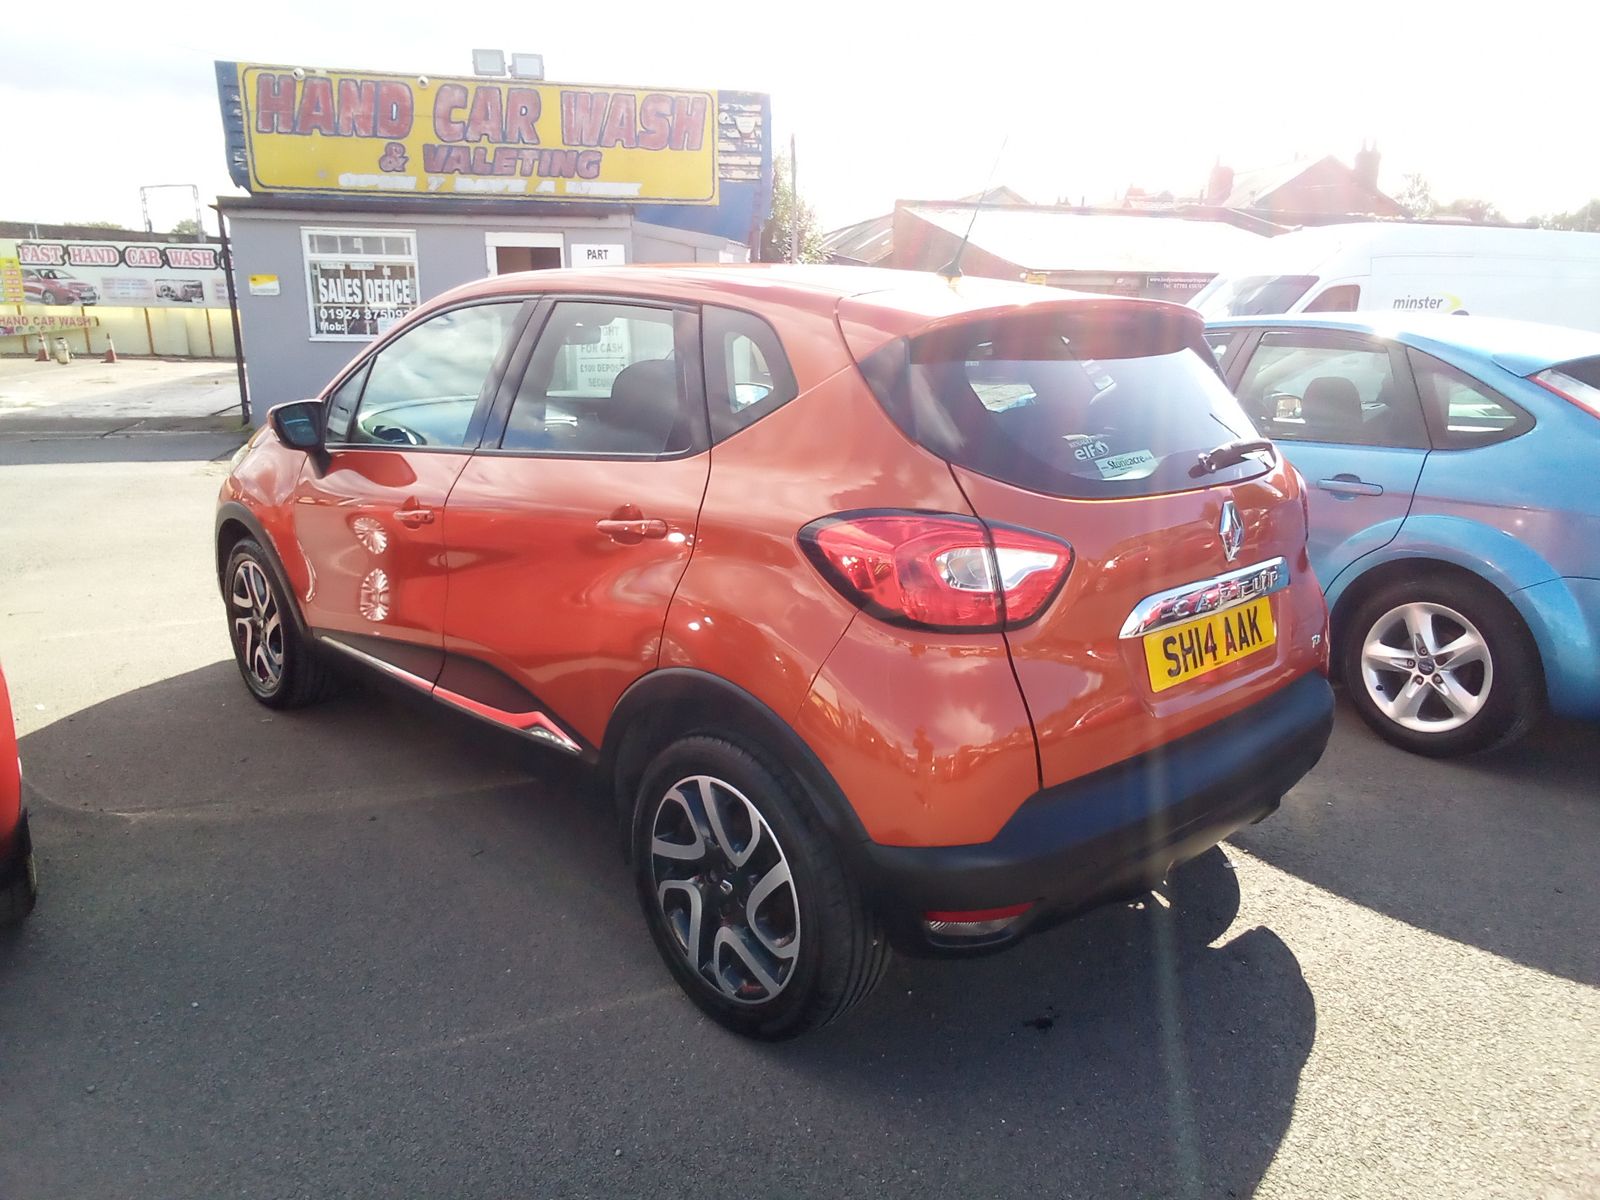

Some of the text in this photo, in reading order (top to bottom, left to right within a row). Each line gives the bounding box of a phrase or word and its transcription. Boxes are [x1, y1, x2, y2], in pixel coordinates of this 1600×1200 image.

[256, 73, 707, 151] HAND CAR WASH
[378, 142, 603, 180] & VALETING
[19, 244, 215, 268] FAST HAND CAR WASH
[587, 249, 608, 260] PART
[319, 277, 411, 304] SALES OFFICE
[1392, 294, 1443, 309] minster
[33, 315, 55, 326] CAR
[59, 315, 91, 327] WASH
[320, 308, 361, 320] 01924
[581, 343, 624, 353] FOR CASH
[1173, 568, 1280, 618] CAPTUR
[1162, 605, 1264, 678] SH14 AAK
